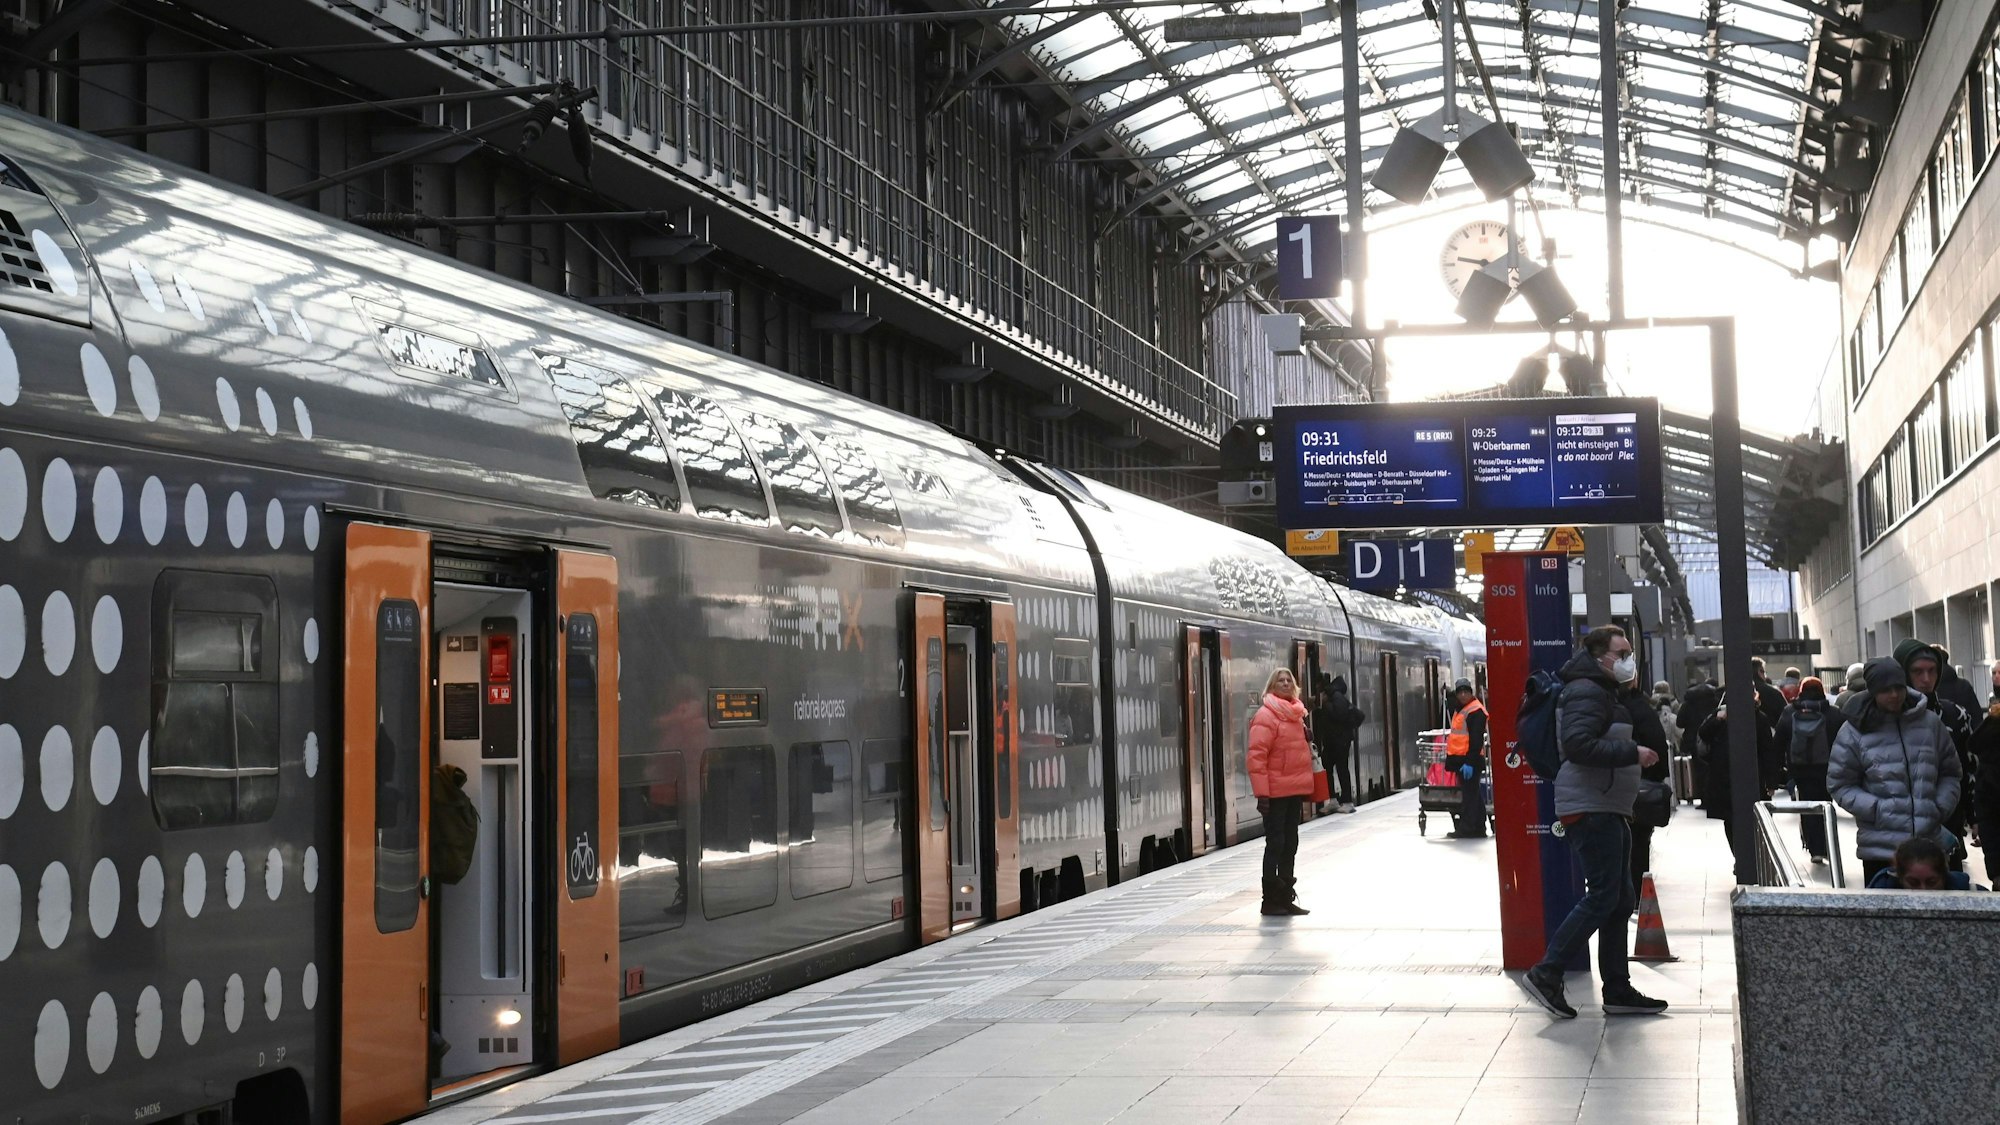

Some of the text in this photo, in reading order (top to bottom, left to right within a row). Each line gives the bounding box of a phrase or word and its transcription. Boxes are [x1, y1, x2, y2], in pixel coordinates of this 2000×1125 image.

[1288, 223, 1313, 279] 1
[1472, 428, 1497, 438] 09:25
[1556, 426, 1582, 436] 09:12
[1302, 431, 1453, 446] 09:31 RE 5 (RRX)
[1473, 442, 1531, 451] W-Oberbarmen
[1557, 440, 1576, 449] nicht
[1578, 440, 1619, 450] einsteigen
[1304, 450, 1388, 466] Friedrichsfeld
[1564, 453, 1574, 461] do
[1575, 452, 1588, 461] not
[1590, 452, 1614, 461] board
[1505, 466, 1528, 474] Solingen
[1354, 540, 1426, 579] D 1
[1542, 559, 1556, 568] DB
[1491, 584, 1516, 596] SOS
[1535, 584, 1558, 596] Info
[898, 658, 906, 698] 2
[794, 691, 846, 726] national express
[259, 1052, 265, 1067] D
[135, 1101, 161, 1120] SIEMENS
